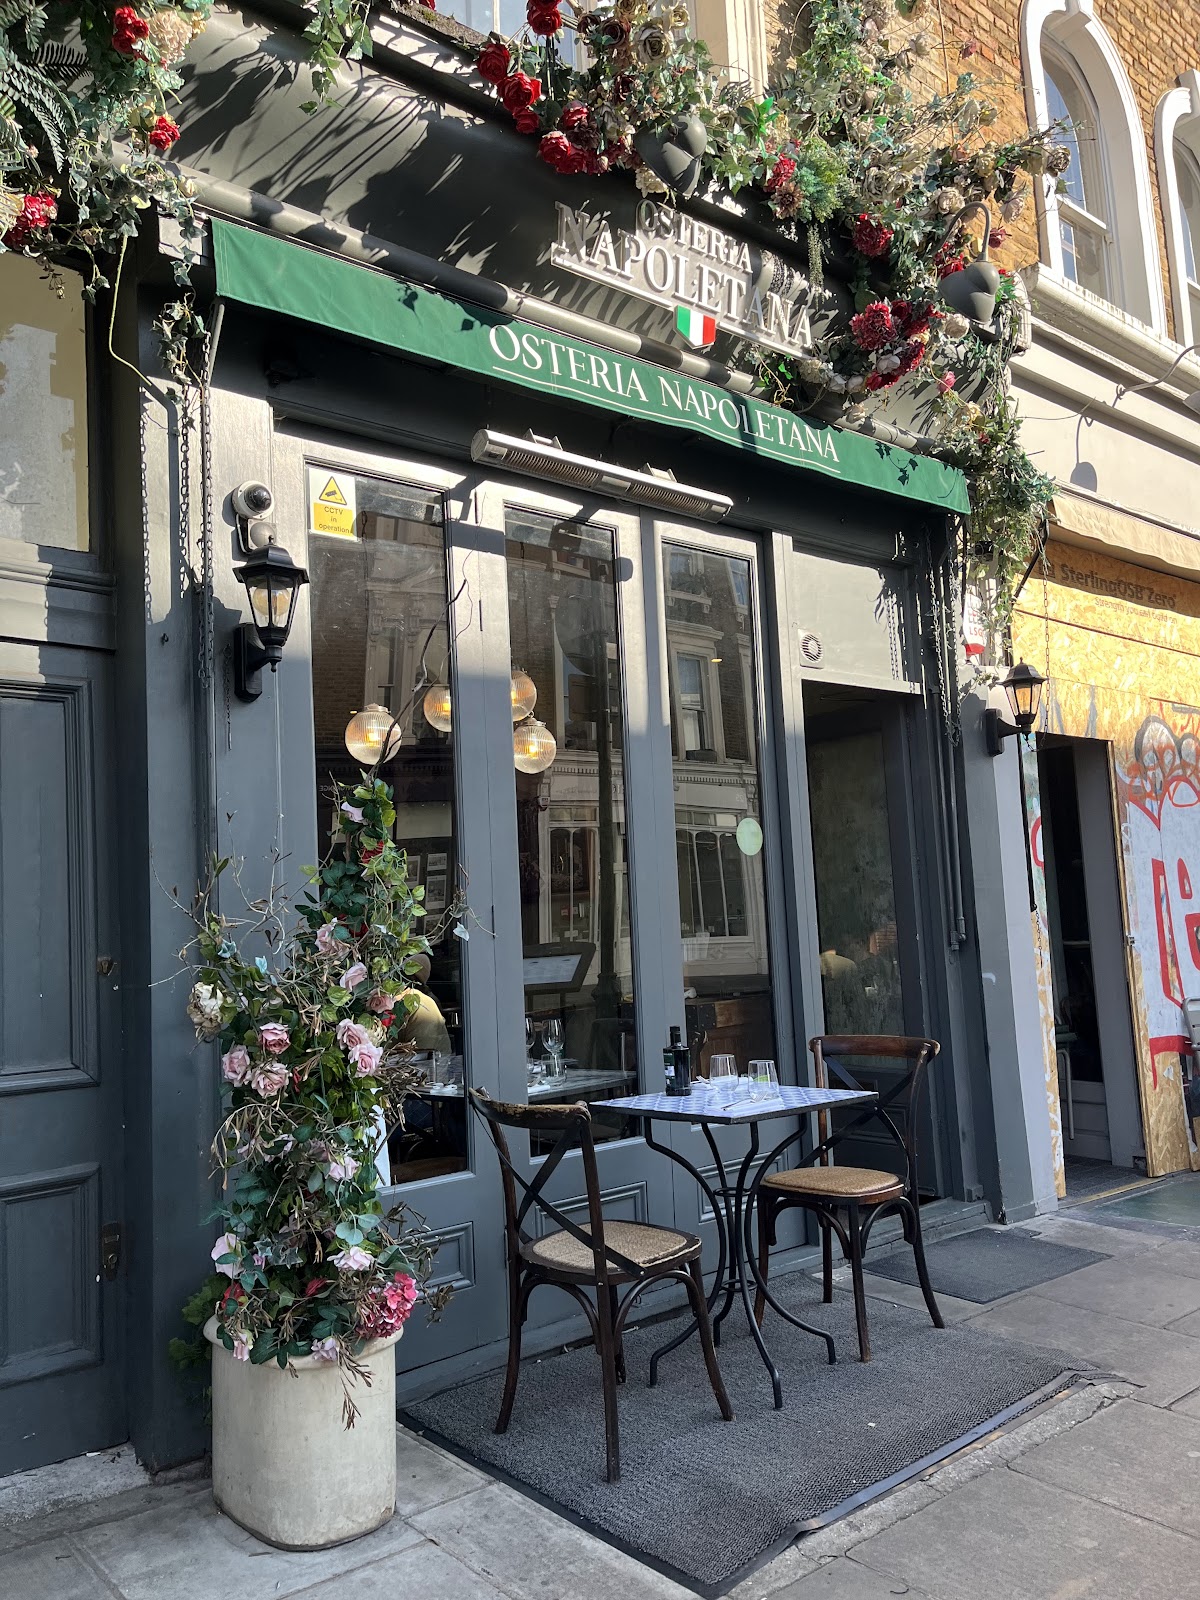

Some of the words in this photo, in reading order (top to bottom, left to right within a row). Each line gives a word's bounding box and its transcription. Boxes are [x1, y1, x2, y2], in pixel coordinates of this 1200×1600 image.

[635, 199, 753, 274] OSTERIA
[554, 200, 813, 349] NAPOLETANA
[489, 324, 649, 402] OSTERIA
[657, 375, 840, 463] NAPOLETANA
[319, 523, 350, 533] operation
[324, 506, 343, 515] CCTV
